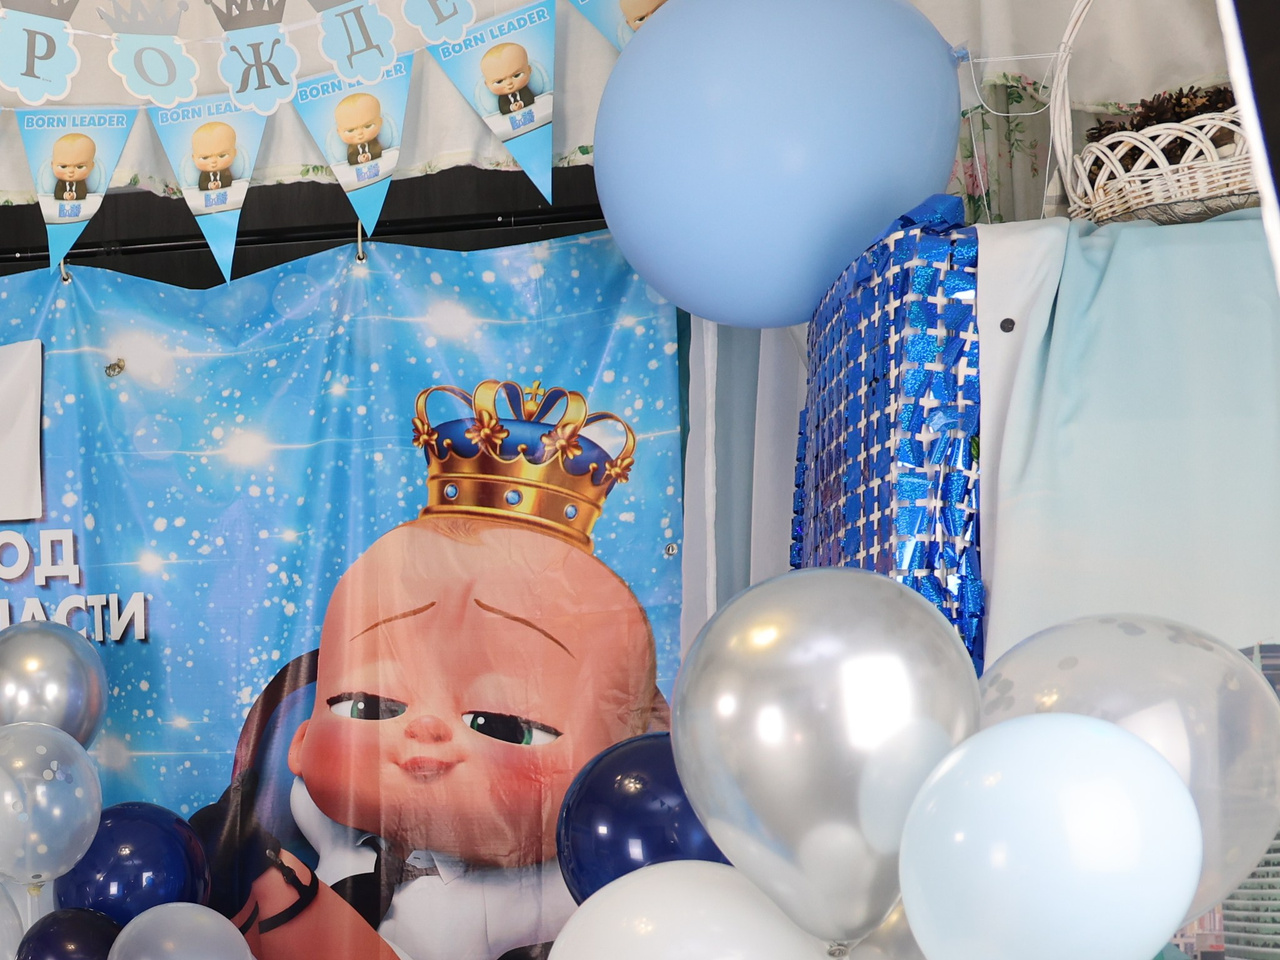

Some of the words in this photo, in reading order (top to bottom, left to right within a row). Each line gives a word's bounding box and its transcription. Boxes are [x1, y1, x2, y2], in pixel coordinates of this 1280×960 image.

[440, 32, 486, 60] BORN
[491, 7, 550, 41] LEADER
[299, 80, 343, 103] BORN
[25, 115, 67, 129] BORN
[71, 114, 127, 128] LEADER
[158, 108, 203, 125] BORN
